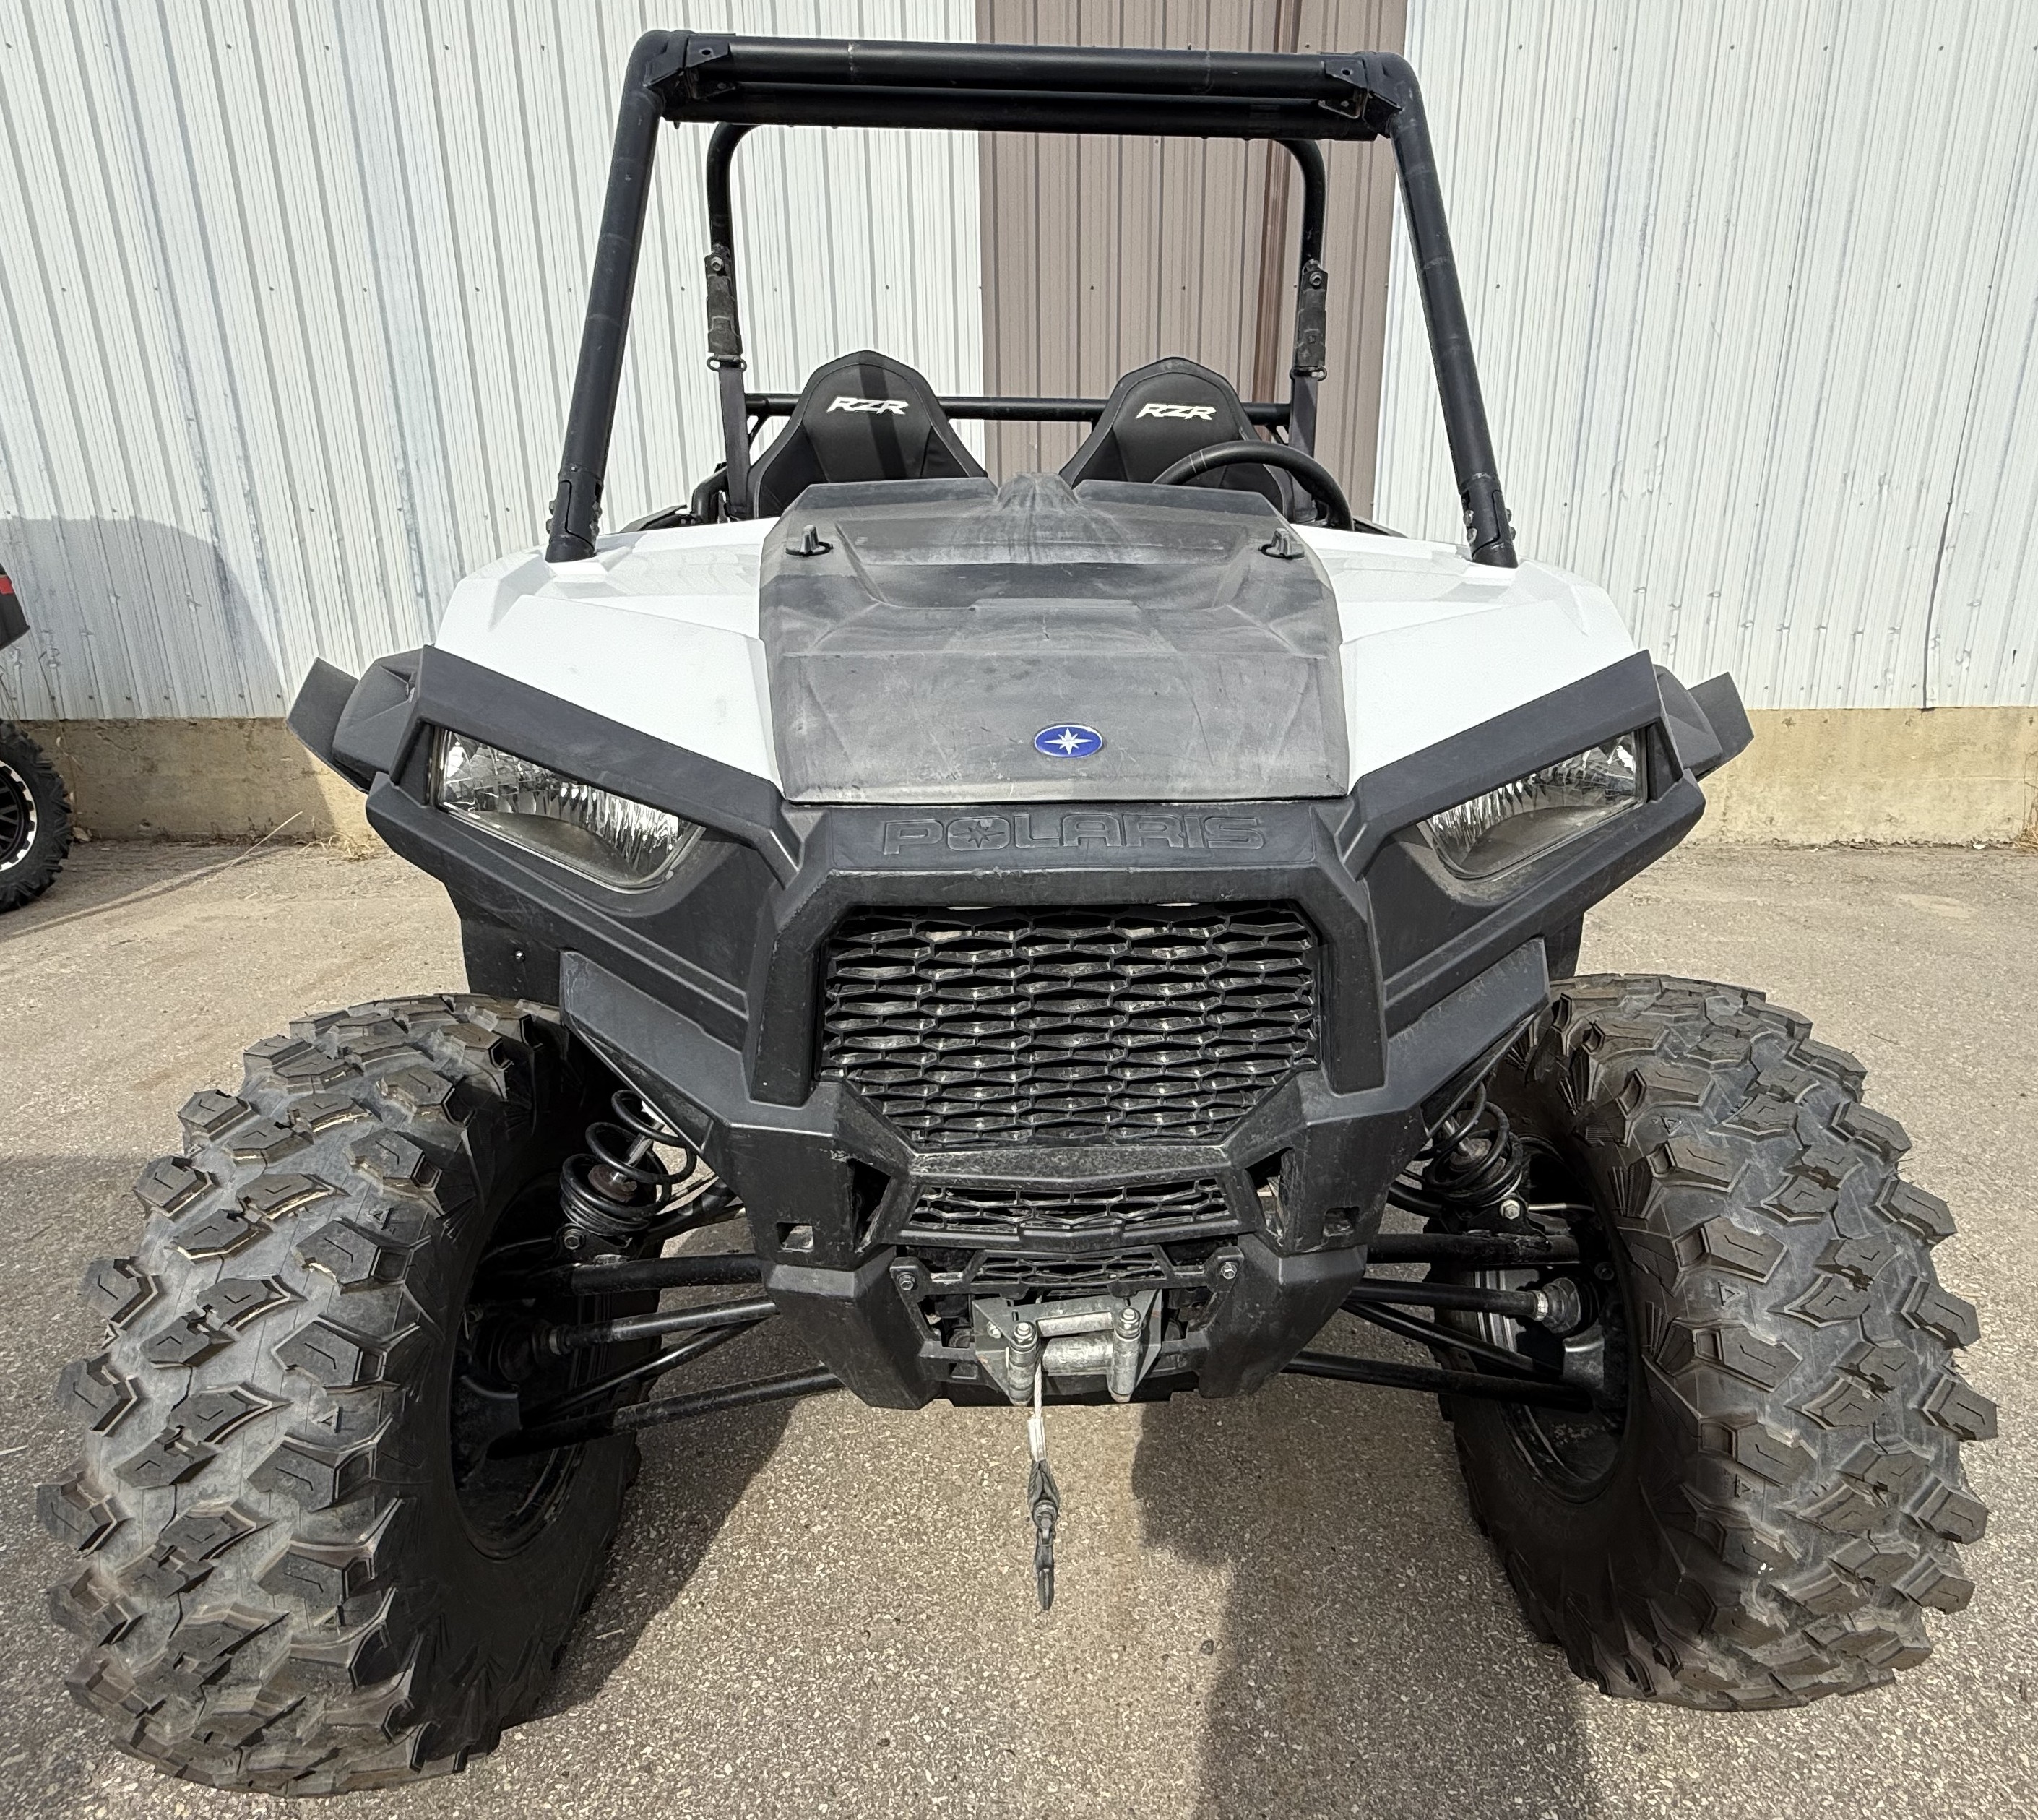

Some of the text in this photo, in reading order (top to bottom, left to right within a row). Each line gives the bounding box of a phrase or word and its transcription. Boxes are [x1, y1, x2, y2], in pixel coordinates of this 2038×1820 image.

[826, 397, 909, 415] RZR
[1136, 403, 1217, 420] RZR
[883, 811, 1266, 855] POLARIS
